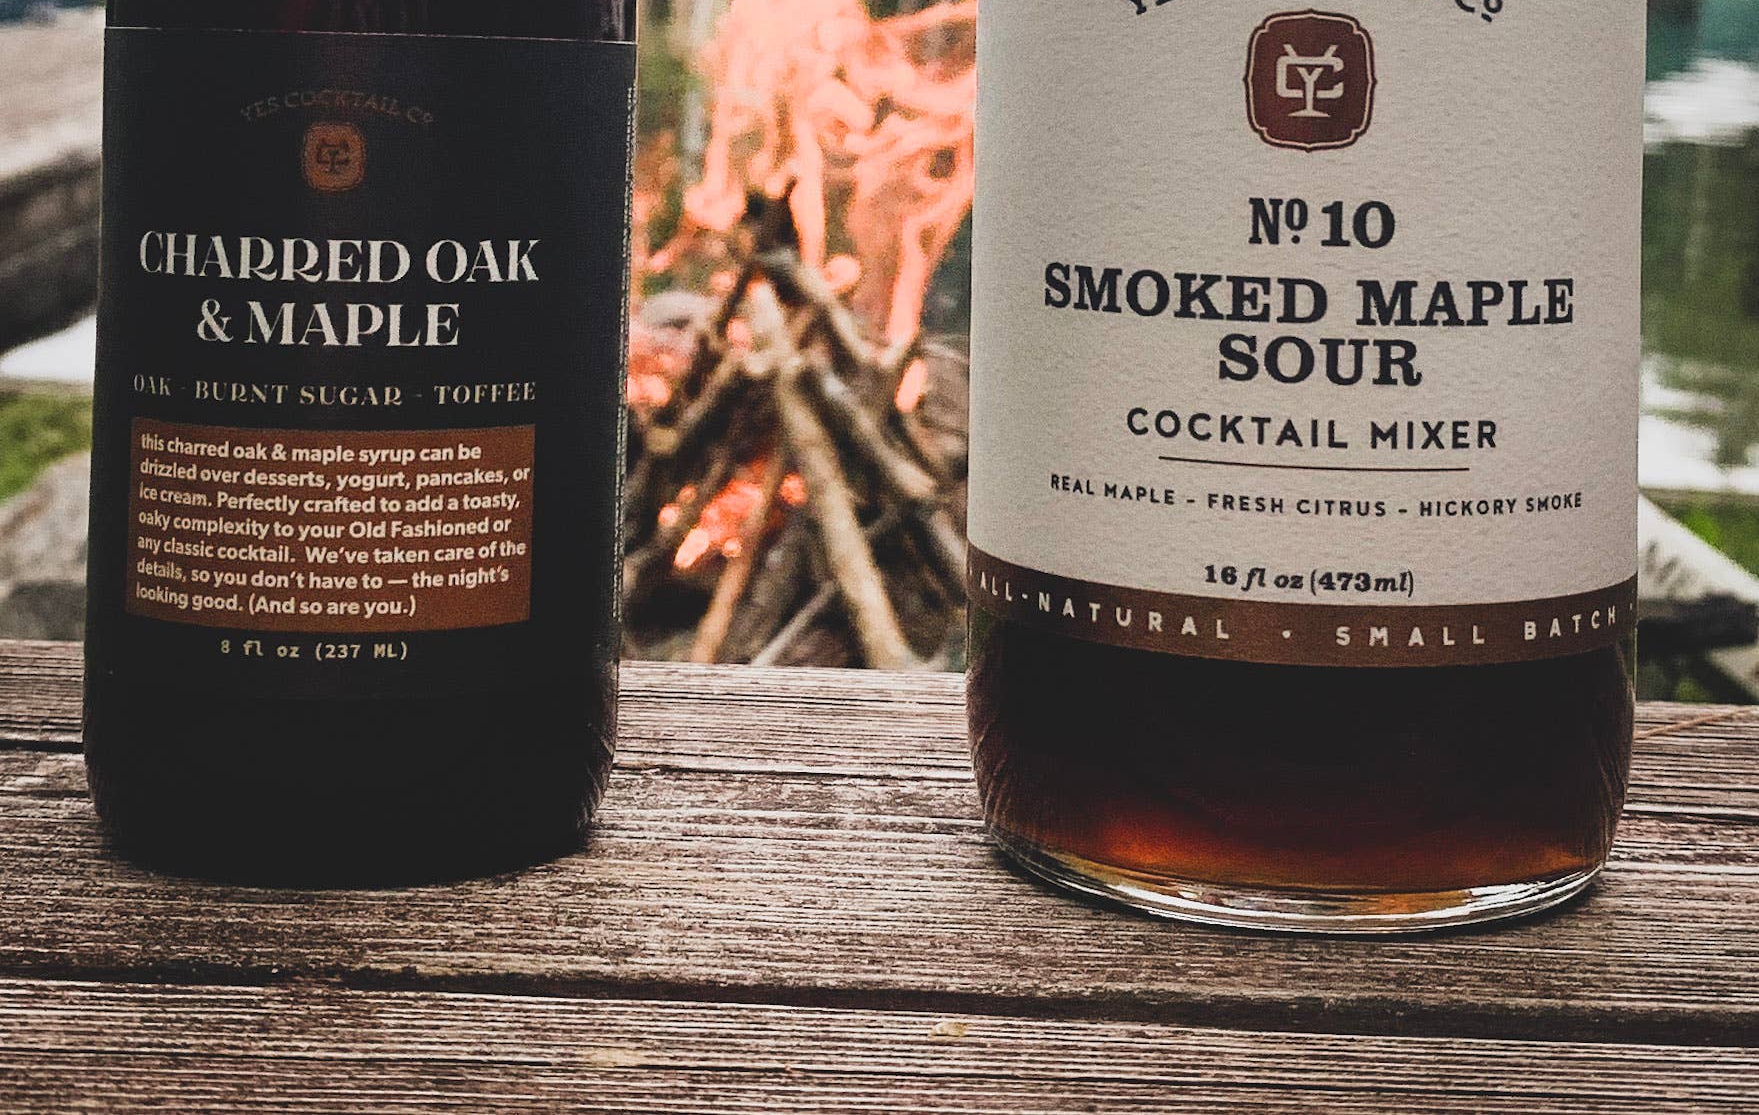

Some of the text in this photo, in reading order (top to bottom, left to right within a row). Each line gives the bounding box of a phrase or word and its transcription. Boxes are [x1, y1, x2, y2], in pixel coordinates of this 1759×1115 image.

[1320, 200, 1396, 250] 10
[140, 231, 539, 283] CHARRED OAK
[1044, 261, 1574, 327] SMOKED MAPLE
[196, 299, 460, 347] & MAPLE
[1218, 333, 1423, 387] SOUR
[133, 374, 171, 396] OAK
[195, 380, 289, 404] BURNT
[299, 386, 402, 406] SUGAR
[433, 382, 535, 405] TOFFEE
[1126, 407, 1497, 450] COCKTAIL MIXER
[141, 434, 482, 465] this charred oak & maple syrup can be
[140, 458, 531, 491] drizzled over desserts, yogurt, pancakes, or
[160, 489, 212, 507] cream.
[217, 491, 299, 516] Perfectly
[303, 496, 375, 513] crafted
[380, 498, 401, 512] to
[405, 495, 443, 511] add
[448, 498, 459, 510] a
[463, 492, 520, 510] toasty,
[1050, 473, 1095, 496] REAL
[1104, 482, 1175, 506] MAPLE
[1207, 493, 1284, 514] FRESH
[1296, 499, 1386, 518] CITRUS
[1419, 498, 1517, 517] HICKORY
[1525, 491, 1582, 513] SMOKE
[139, 509, 512, 541] oaky complexity to your Old Fashioned or
[137, 536, 526, 565] any classic cocktail. We've taken care of the
[136, 558, 187, 582] details,
[191, 569, 210, 583] so
[213, 572, 247, 587] you
[251, 570, 305, 589] don't
[309, 572, 358, 590] have
[361, 574, 383, 589] to
[412, 571, 444, 588] the
[448, 565, 510, 589] night's
[1204, 564, 1414, 598] 16 fl oz (473ml)
[136, 582, 416, 619] looking good. (And so are you.)
[979, 571, 1616, 647] ALL-NATURAL SMALL BATCH
[220, 639, 408, 661] 8 fl oz (237 ML)
